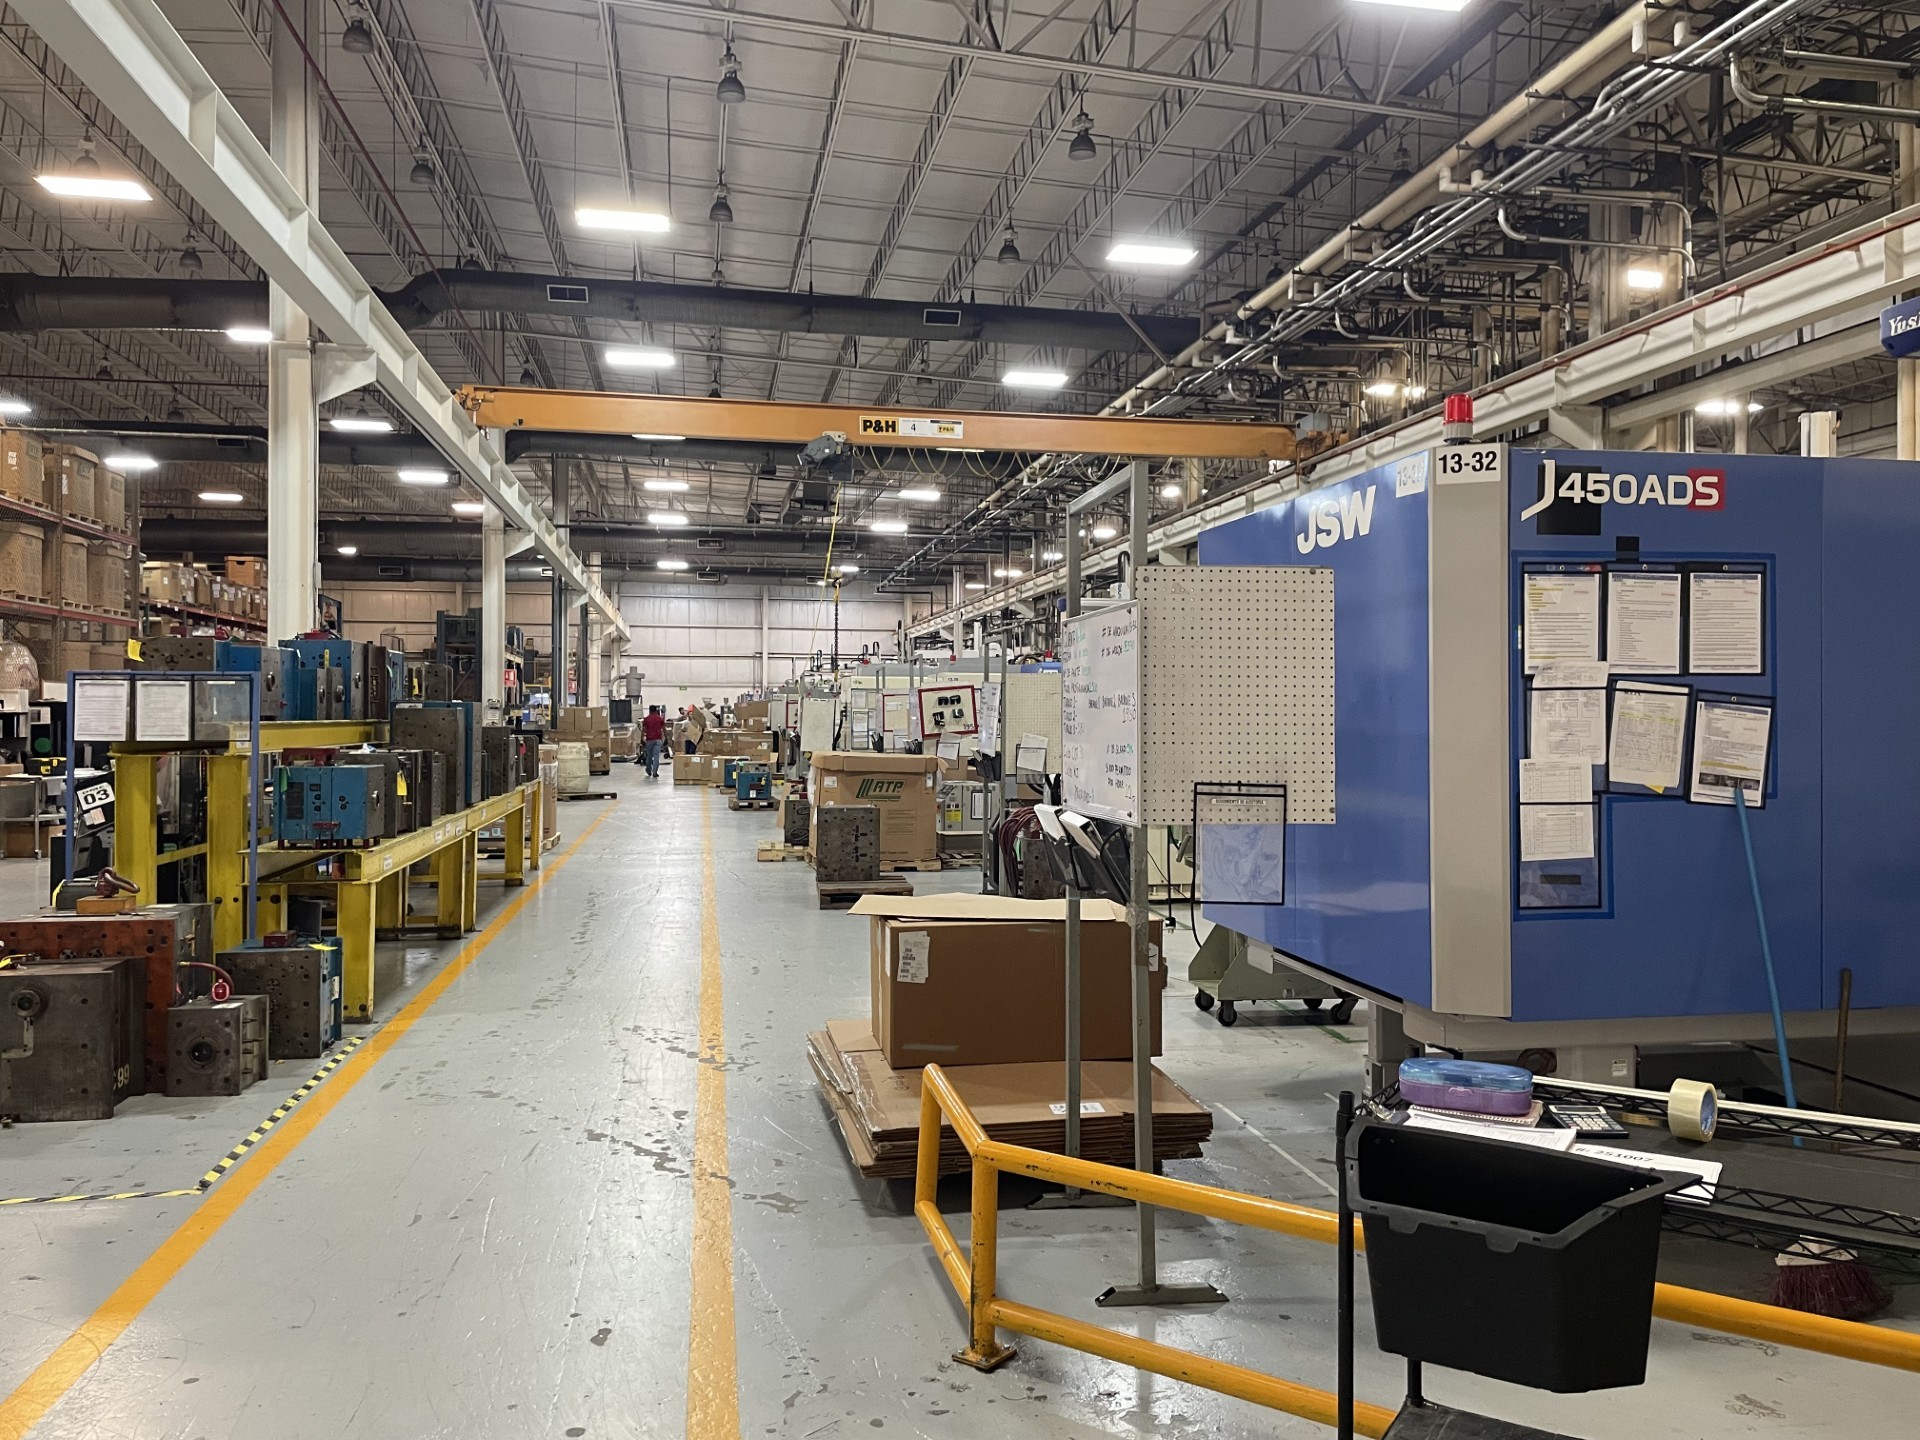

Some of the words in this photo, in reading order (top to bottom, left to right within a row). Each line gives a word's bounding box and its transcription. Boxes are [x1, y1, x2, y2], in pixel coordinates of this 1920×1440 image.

[862, 419, 897, 434] P&H
[910, 423, 916, 432] 4
[1438, 451, 1498, 474] 13-32
[1521, 459, 1720, 522] J450ADS
[1296, 484, 1377, 554] JSW
[873, 781, 905, 793] ATP
[83, 788, 110, 805] 03
[1594, 1149, 1654, 1162] 251007
